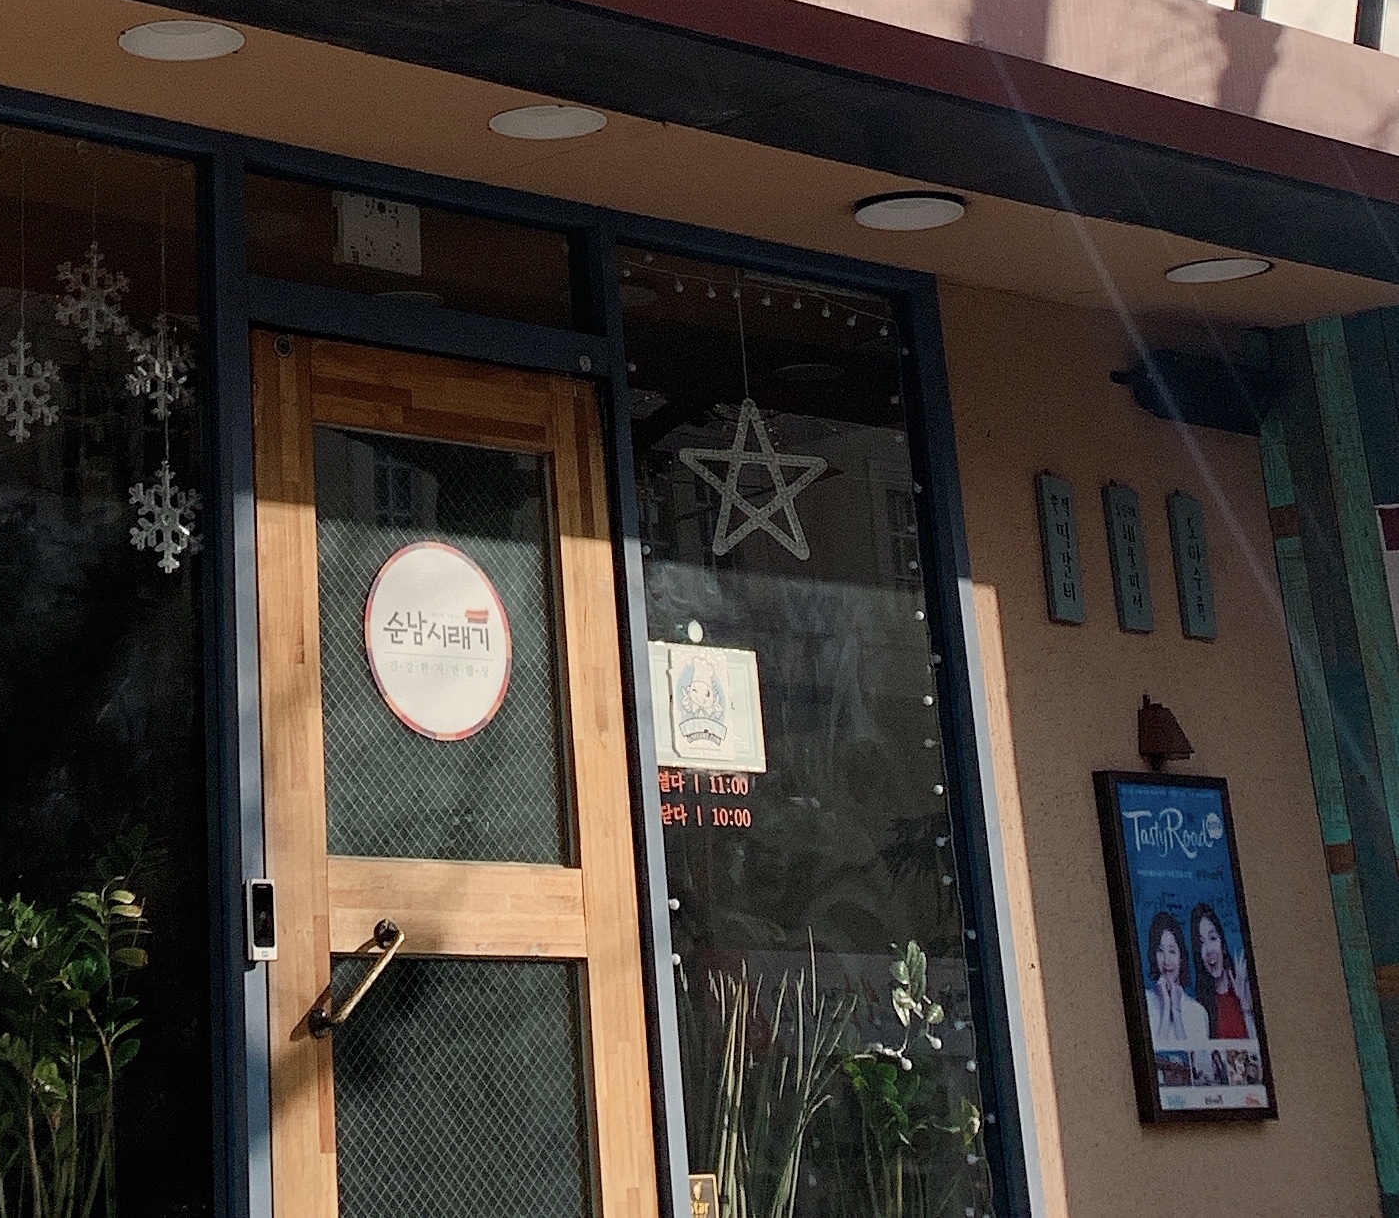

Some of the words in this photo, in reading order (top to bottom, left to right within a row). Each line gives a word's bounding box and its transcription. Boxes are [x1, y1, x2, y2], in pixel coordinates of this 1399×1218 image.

[383, 611, 489, 651] 순남시래기
[709, 776, 749, 795] 11:00
[712, 808, 752, 828] 10:00
